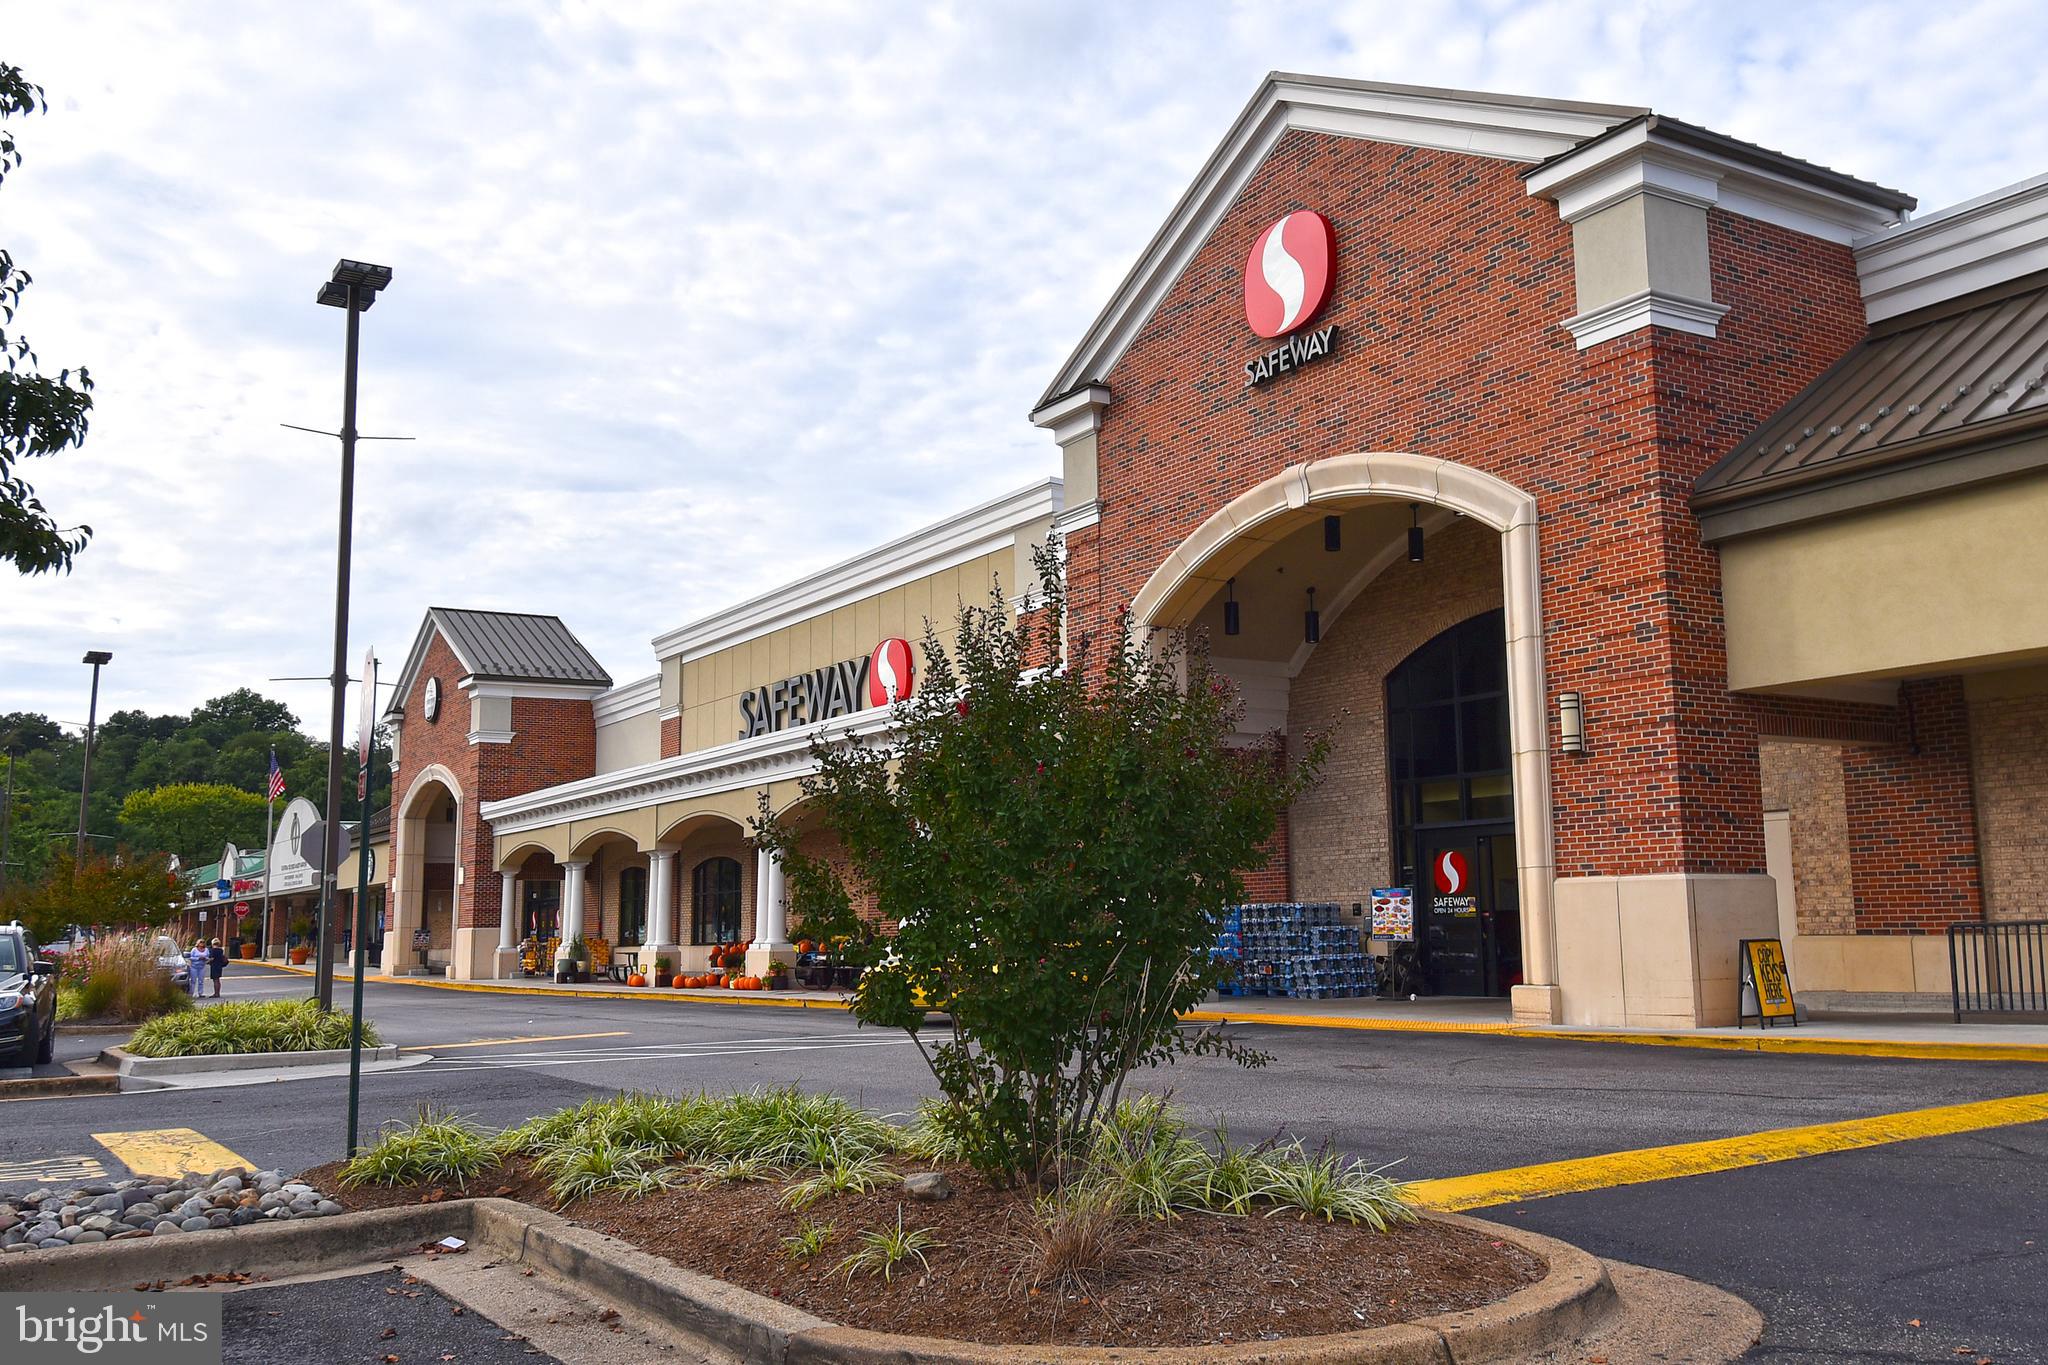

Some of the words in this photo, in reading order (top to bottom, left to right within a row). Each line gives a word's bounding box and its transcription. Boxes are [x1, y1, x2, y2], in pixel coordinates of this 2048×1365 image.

[1244, 325, 1339, 388] SAFEWAY
[739, 655, 870, 740] SAFEWAY
[1433, 897, 1469, 907] SAFEWAY
[1757, 946, 1776, 964] COPY
[1759, 963, 1782, 983] KEYS
[1764, 983, 1785, 999] HERE
